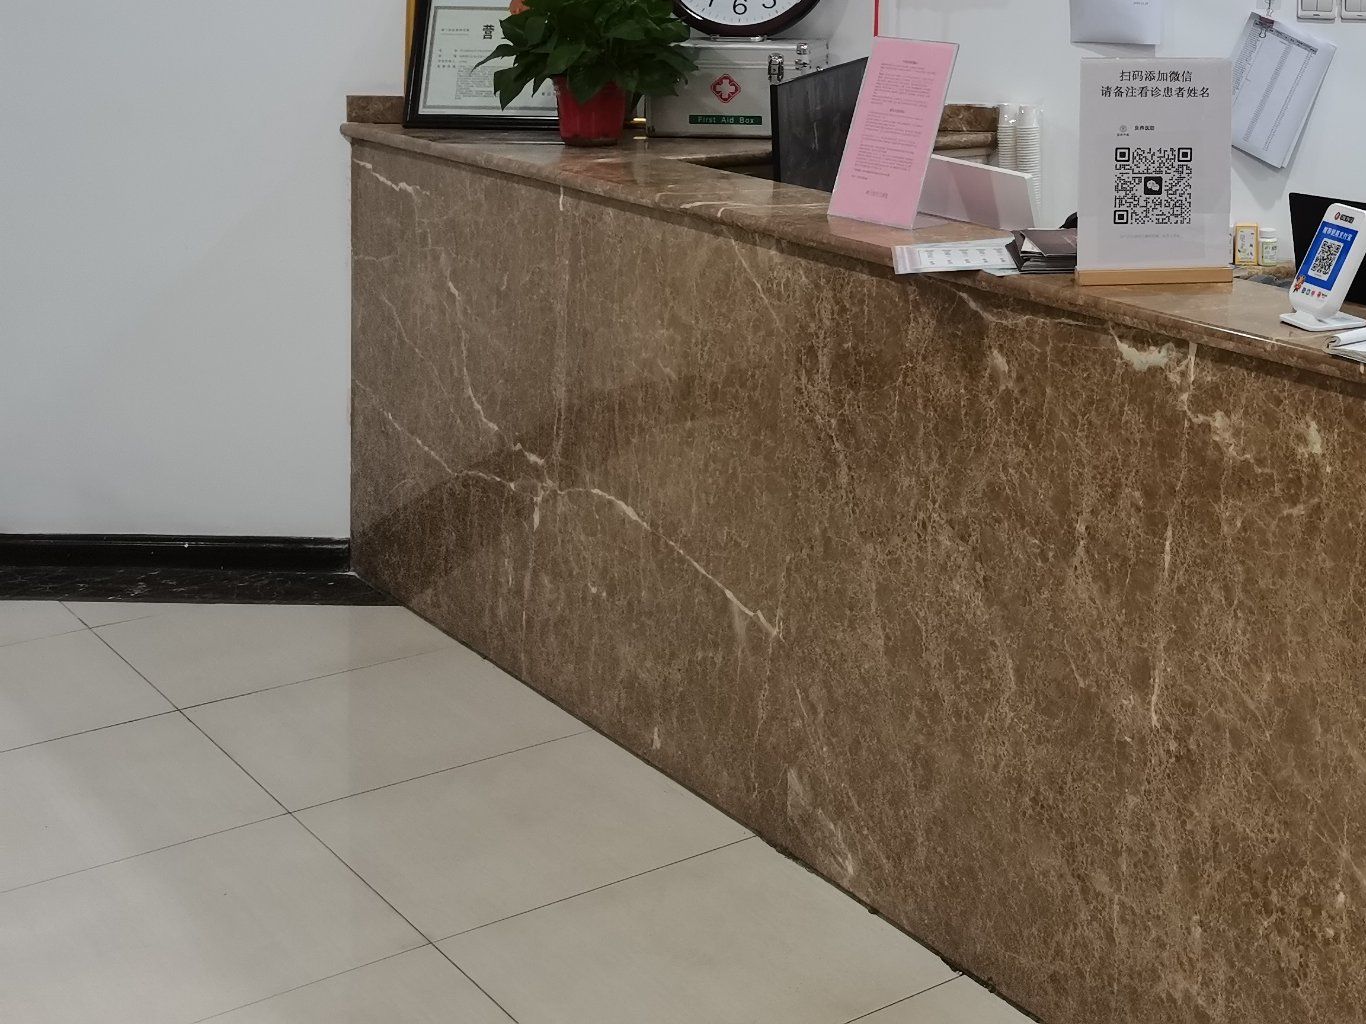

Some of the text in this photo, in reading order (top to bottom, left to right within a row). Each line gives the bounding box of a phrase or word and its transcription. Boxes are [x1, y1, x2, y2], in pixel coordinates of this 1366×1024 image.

[1120, 70, 1192, 82] 扫码添加微信
[1101, 86, 1210, 98] 请备注看诊患者姓名
